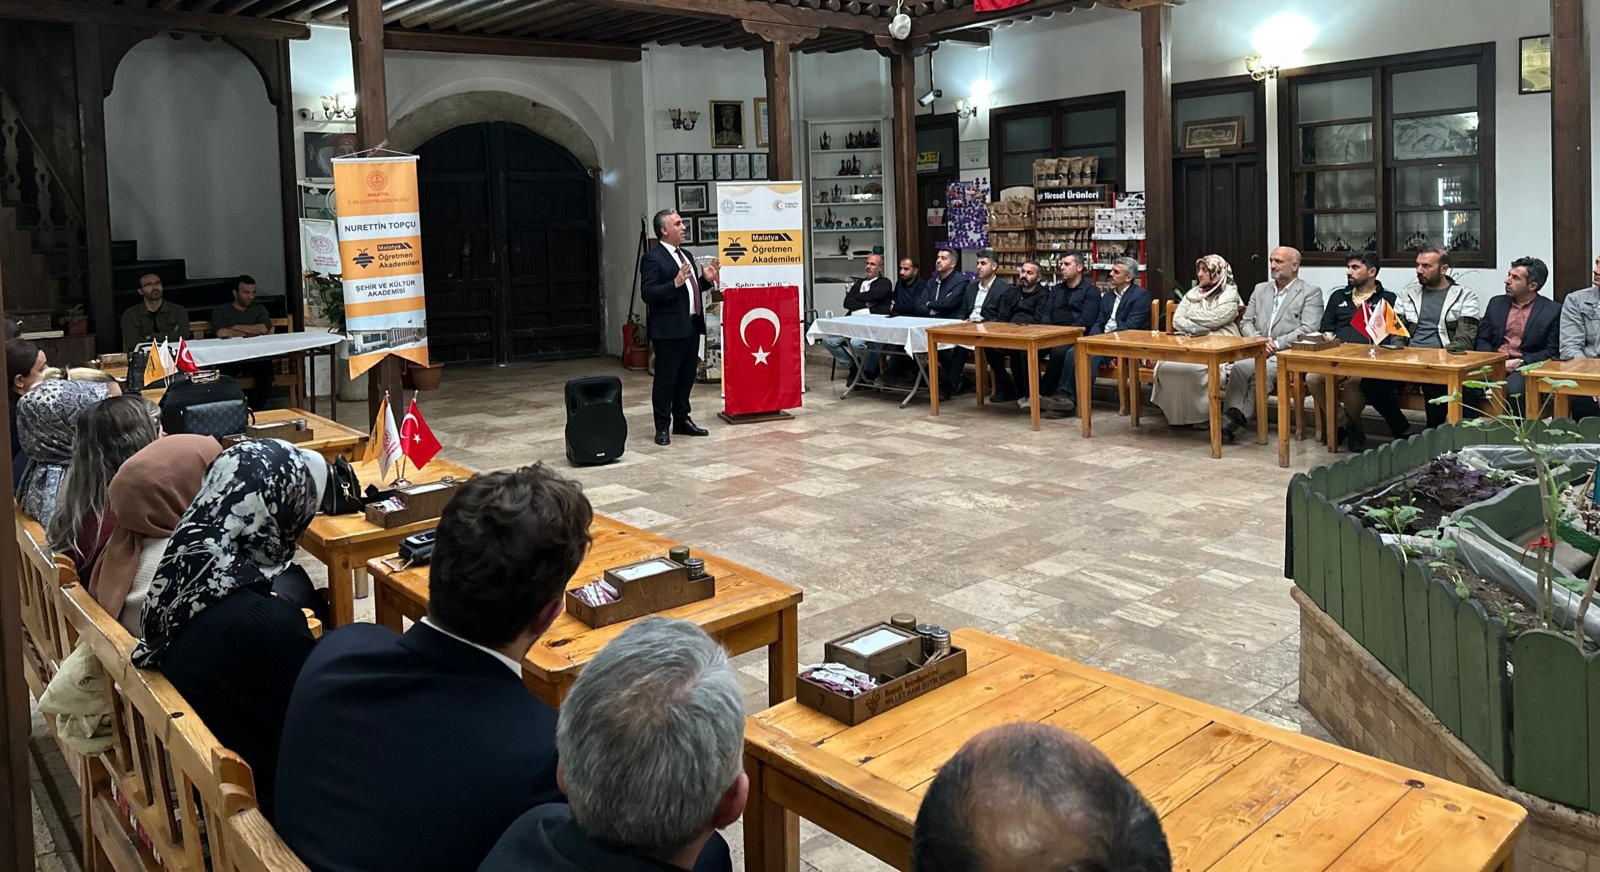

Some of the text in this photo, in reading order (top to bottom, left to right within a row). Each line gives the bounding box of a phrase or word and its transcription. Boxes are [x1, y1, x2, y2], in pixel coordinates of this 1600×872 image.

[1044, 191, 1066, 200] Yöresel
[1067, 189, 1099, 199] Ürünleri
[345, 221, 416, 232] NURETTİN TOPÇU
[752, 234, 779, 242] Malatya
[752, 245, 793, 255] Öğretmen
[378, 253, 413, 261] Öğretmen
[752, 254, 801, 263] Akademileri
[379, 260, 420, 269] Akademileri
[355, 284, 377, 292] ŞEHİR
[388, 280, 415, 288] KÜLTÜR
[368, 289, 405, 297] AKADEMİSİ
